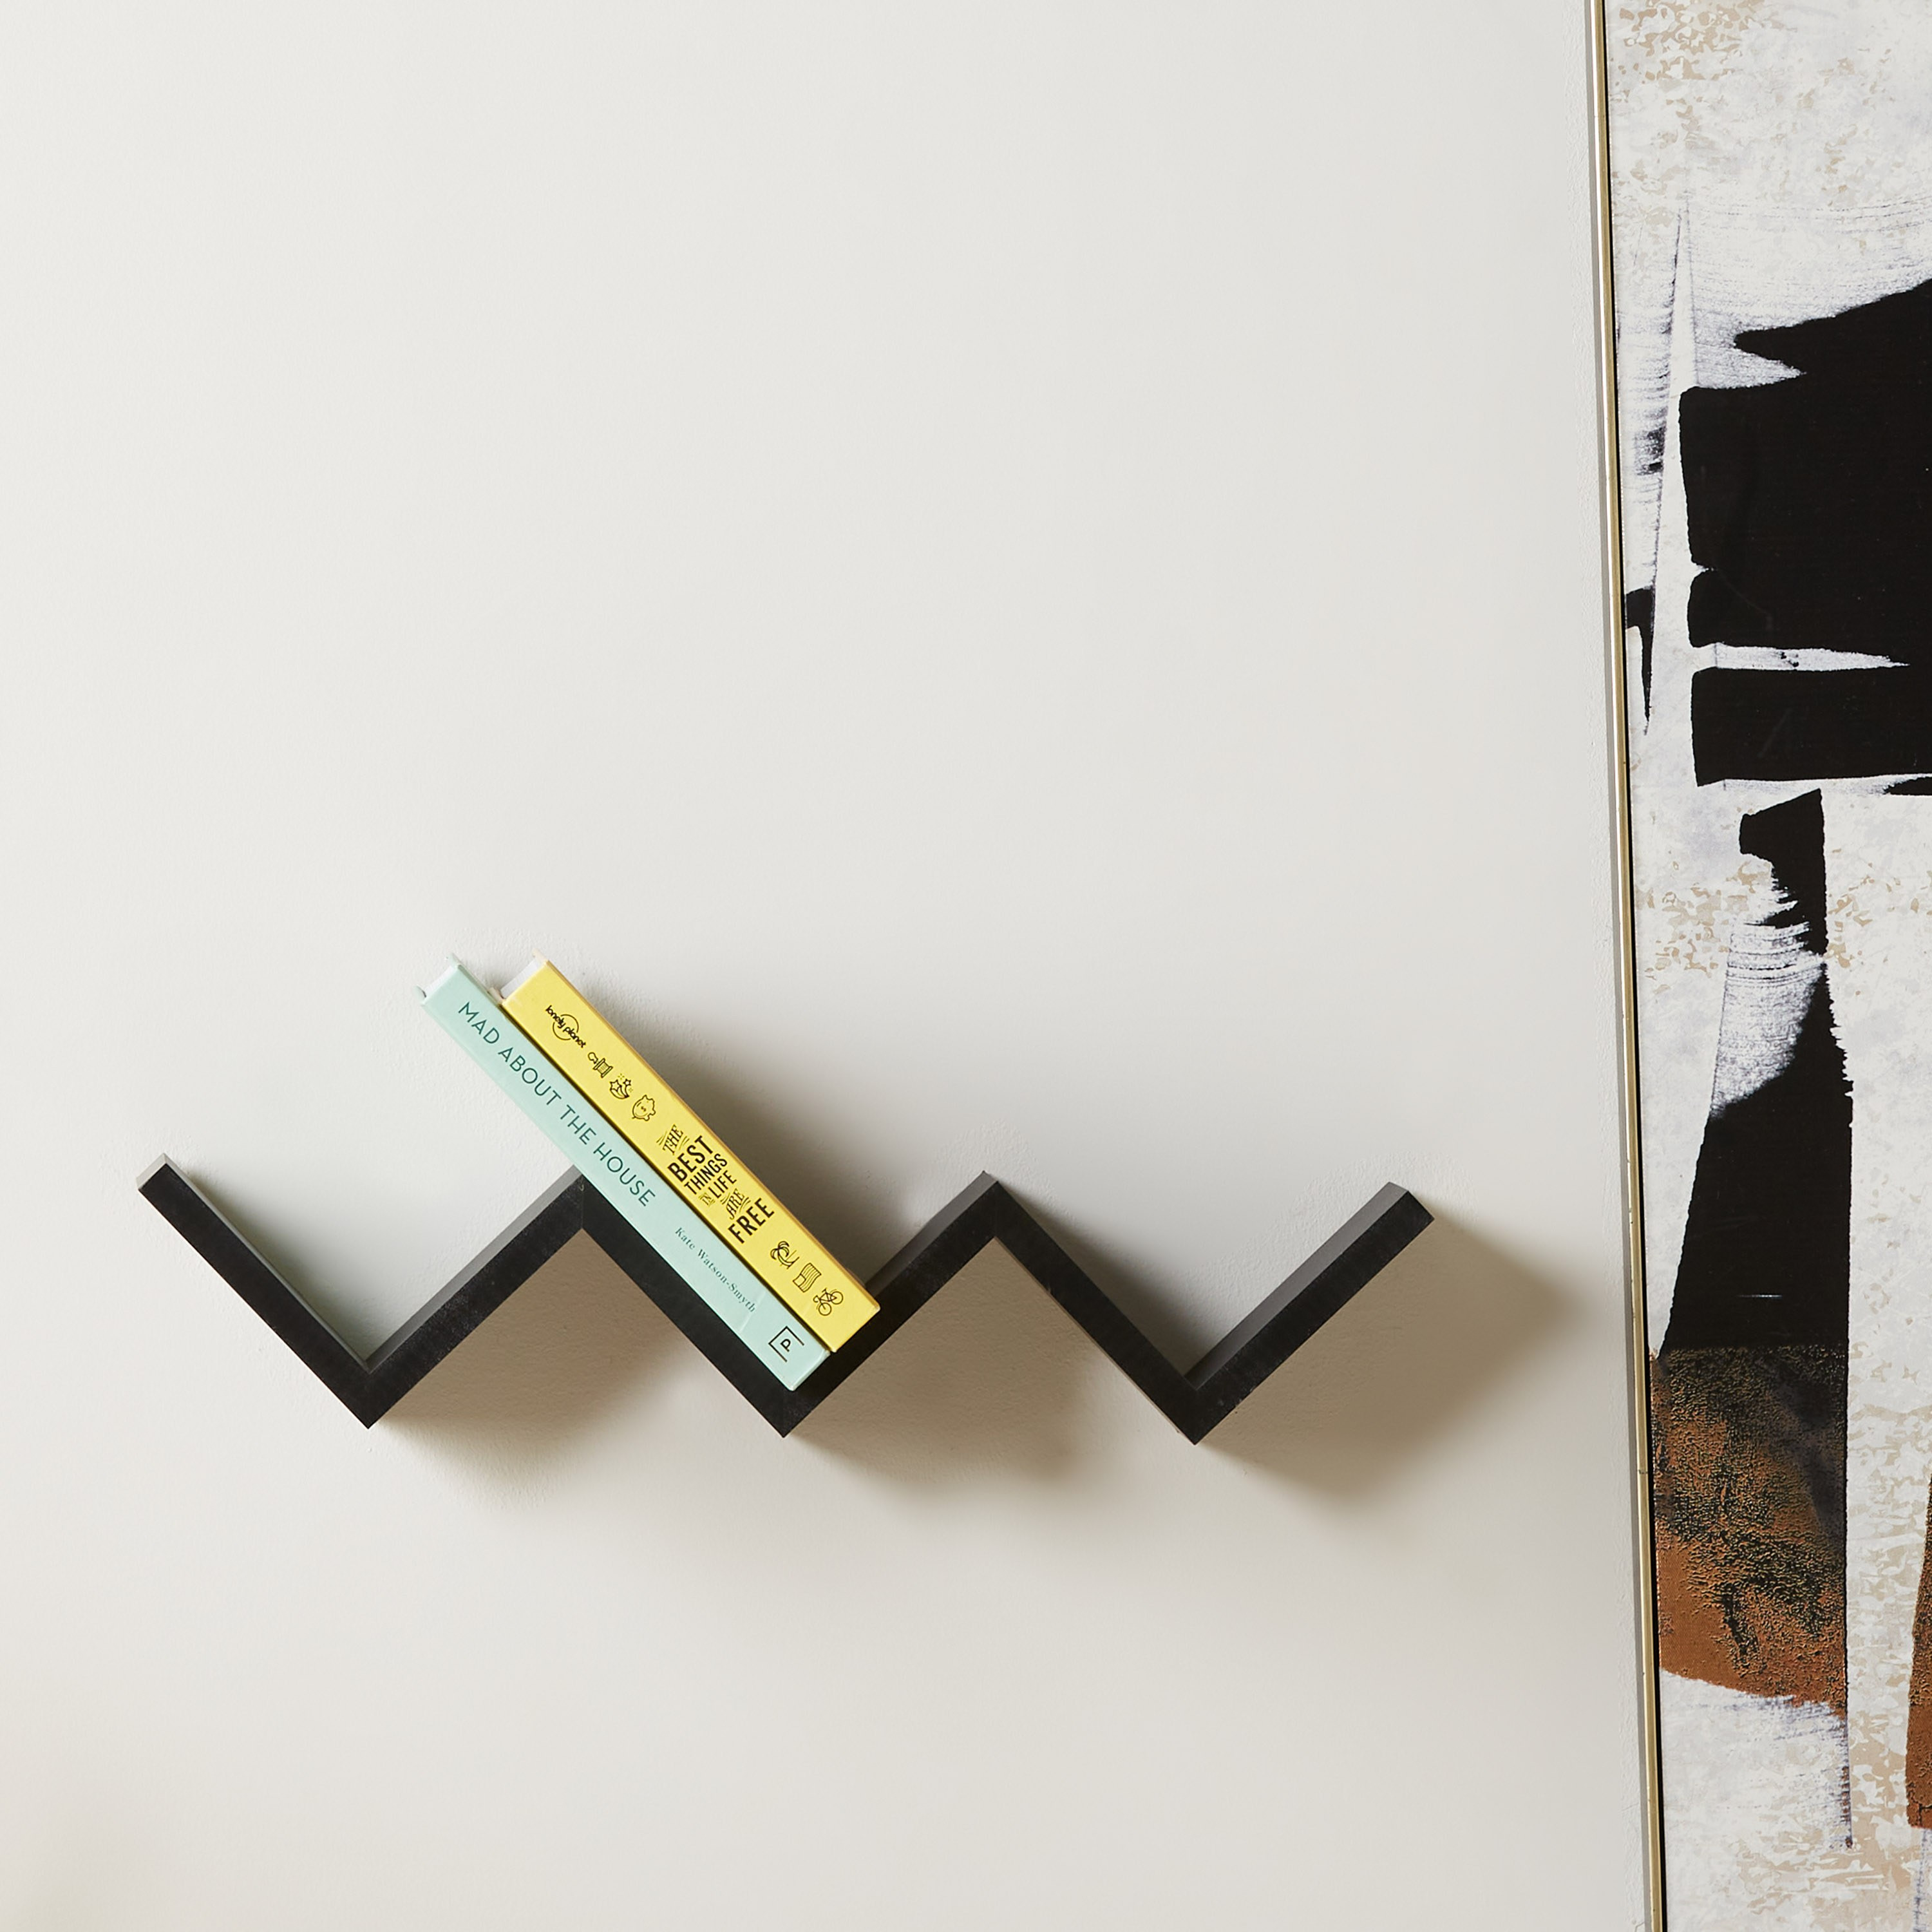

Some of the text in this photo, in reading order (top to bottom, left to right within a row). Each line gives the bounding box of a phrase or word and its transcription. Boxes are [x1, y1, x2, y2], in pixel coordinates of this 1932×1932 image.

[545, 1005, 586, 1048] lonely planet
[458, 1001, 656, 1207] MAD ABOUT THE HOUSE
[662, 1124, 684, 1155] THE
[667, 1135, 713, 1182] BEST
[684, 1153, 728, 1195] THINGS
[700, 1170, 737, 1206] IN LIFE
[725, 1188, 745, 1220] ARE
[728, 1197, 775, 1244] FREE
[675, 1227, 756, 1312] Kate Watson-Smyth
